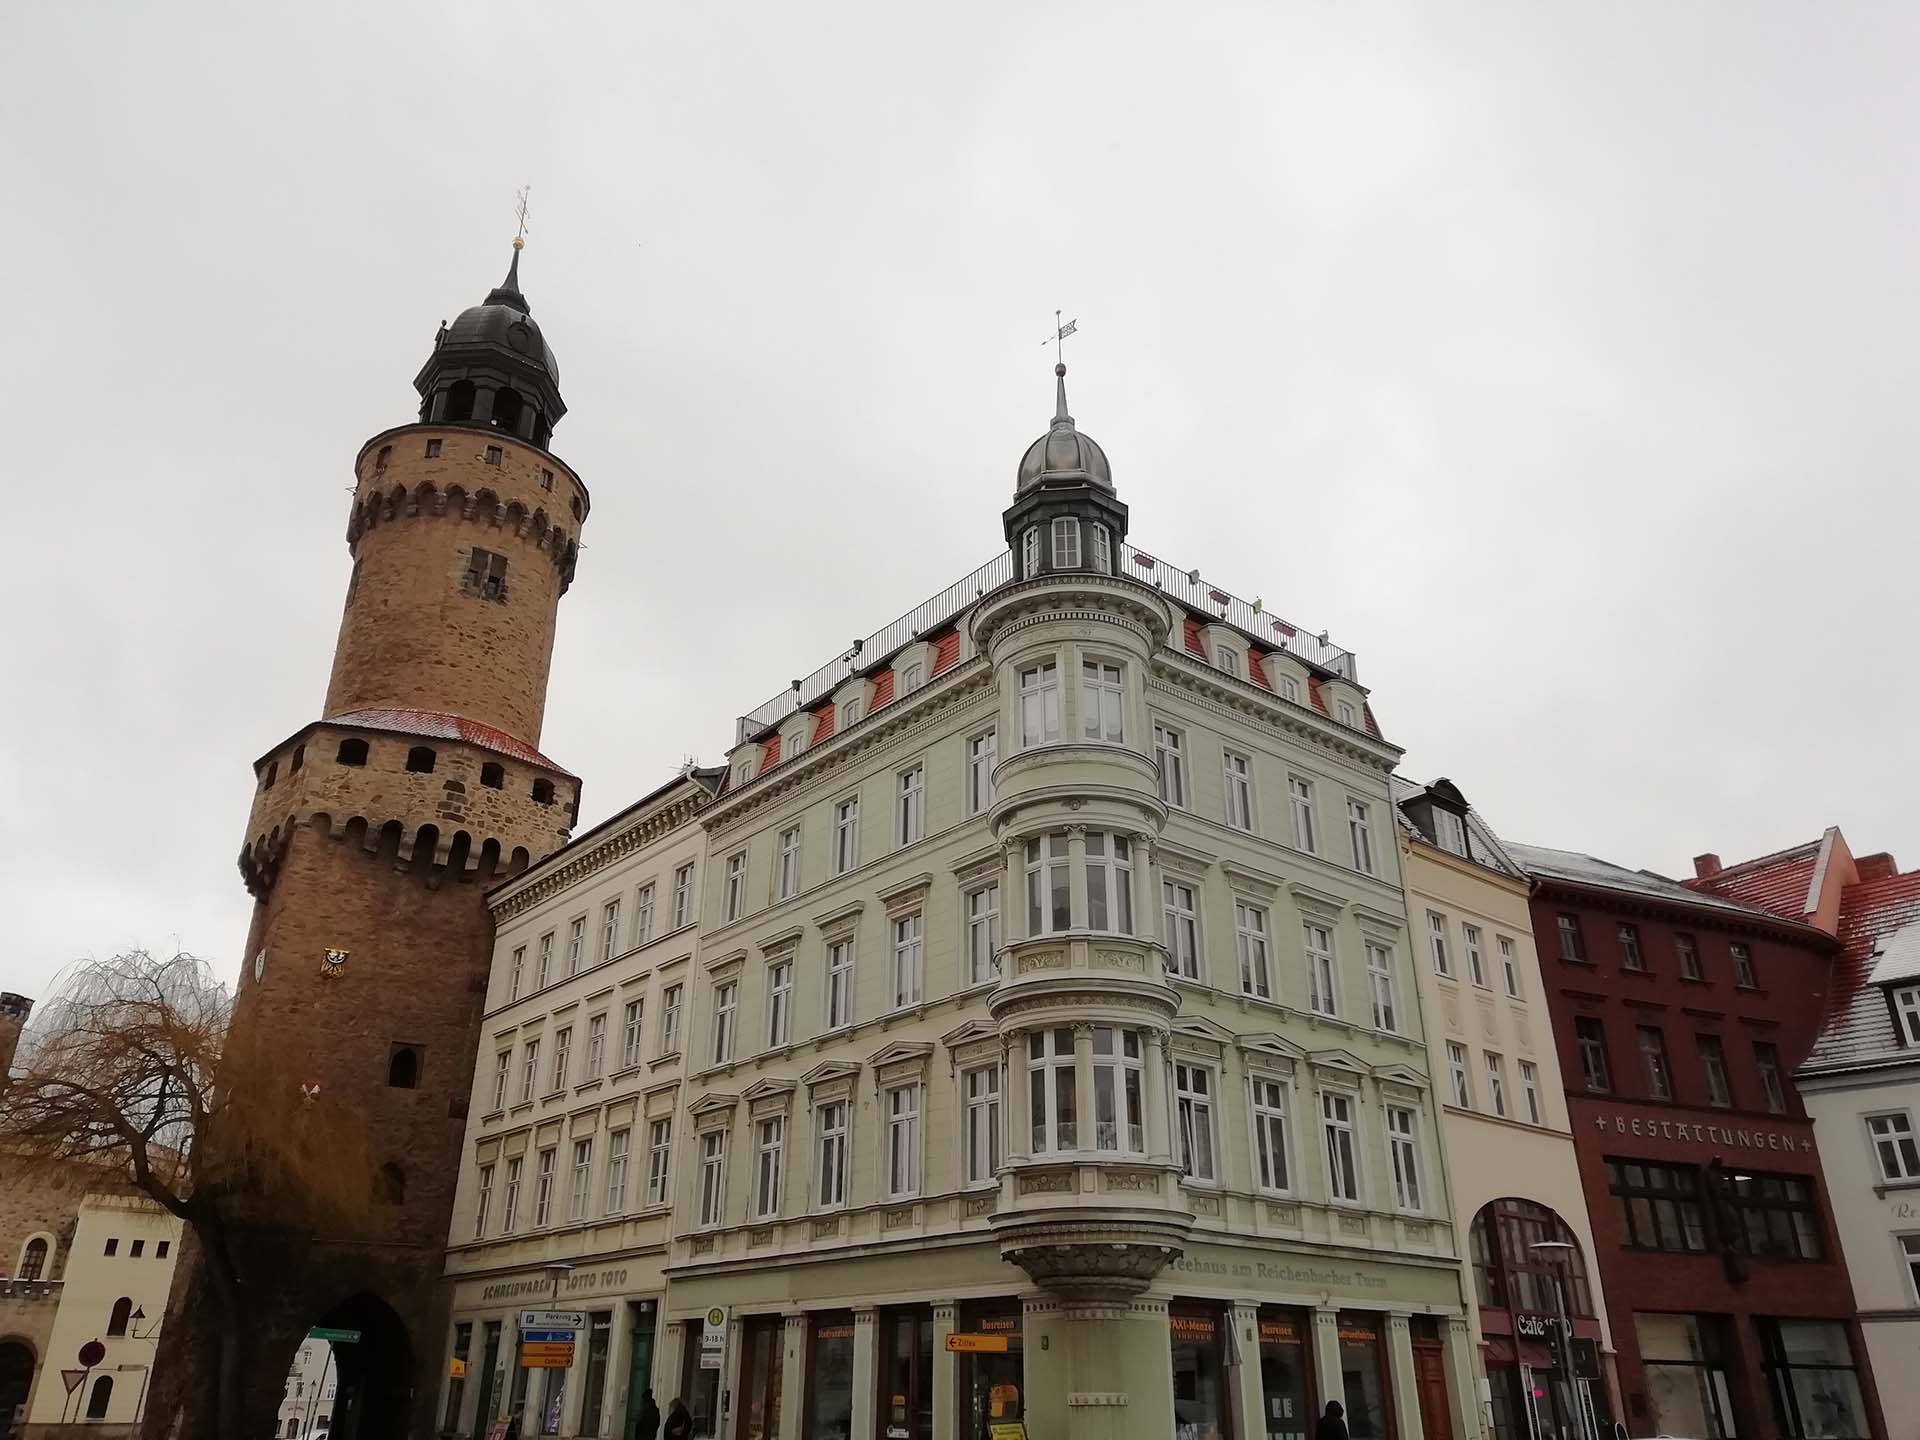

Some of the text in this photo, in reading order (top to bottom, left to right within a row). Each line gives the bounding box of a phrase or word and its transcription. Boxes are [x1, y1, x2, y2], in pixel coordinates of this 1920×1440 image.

[1615, 1116, 1796, 1153] BESTATTUNGEN
[565, 1272, 597, 1291] LOTTO
[600, 1269, 628, 1287] TOTO
[1232, 1264, 1253, 1277] am
[1256, 1263, 1352, 1287] Reichenbacher
[1355, 1272, 1388, 1289] Turm
